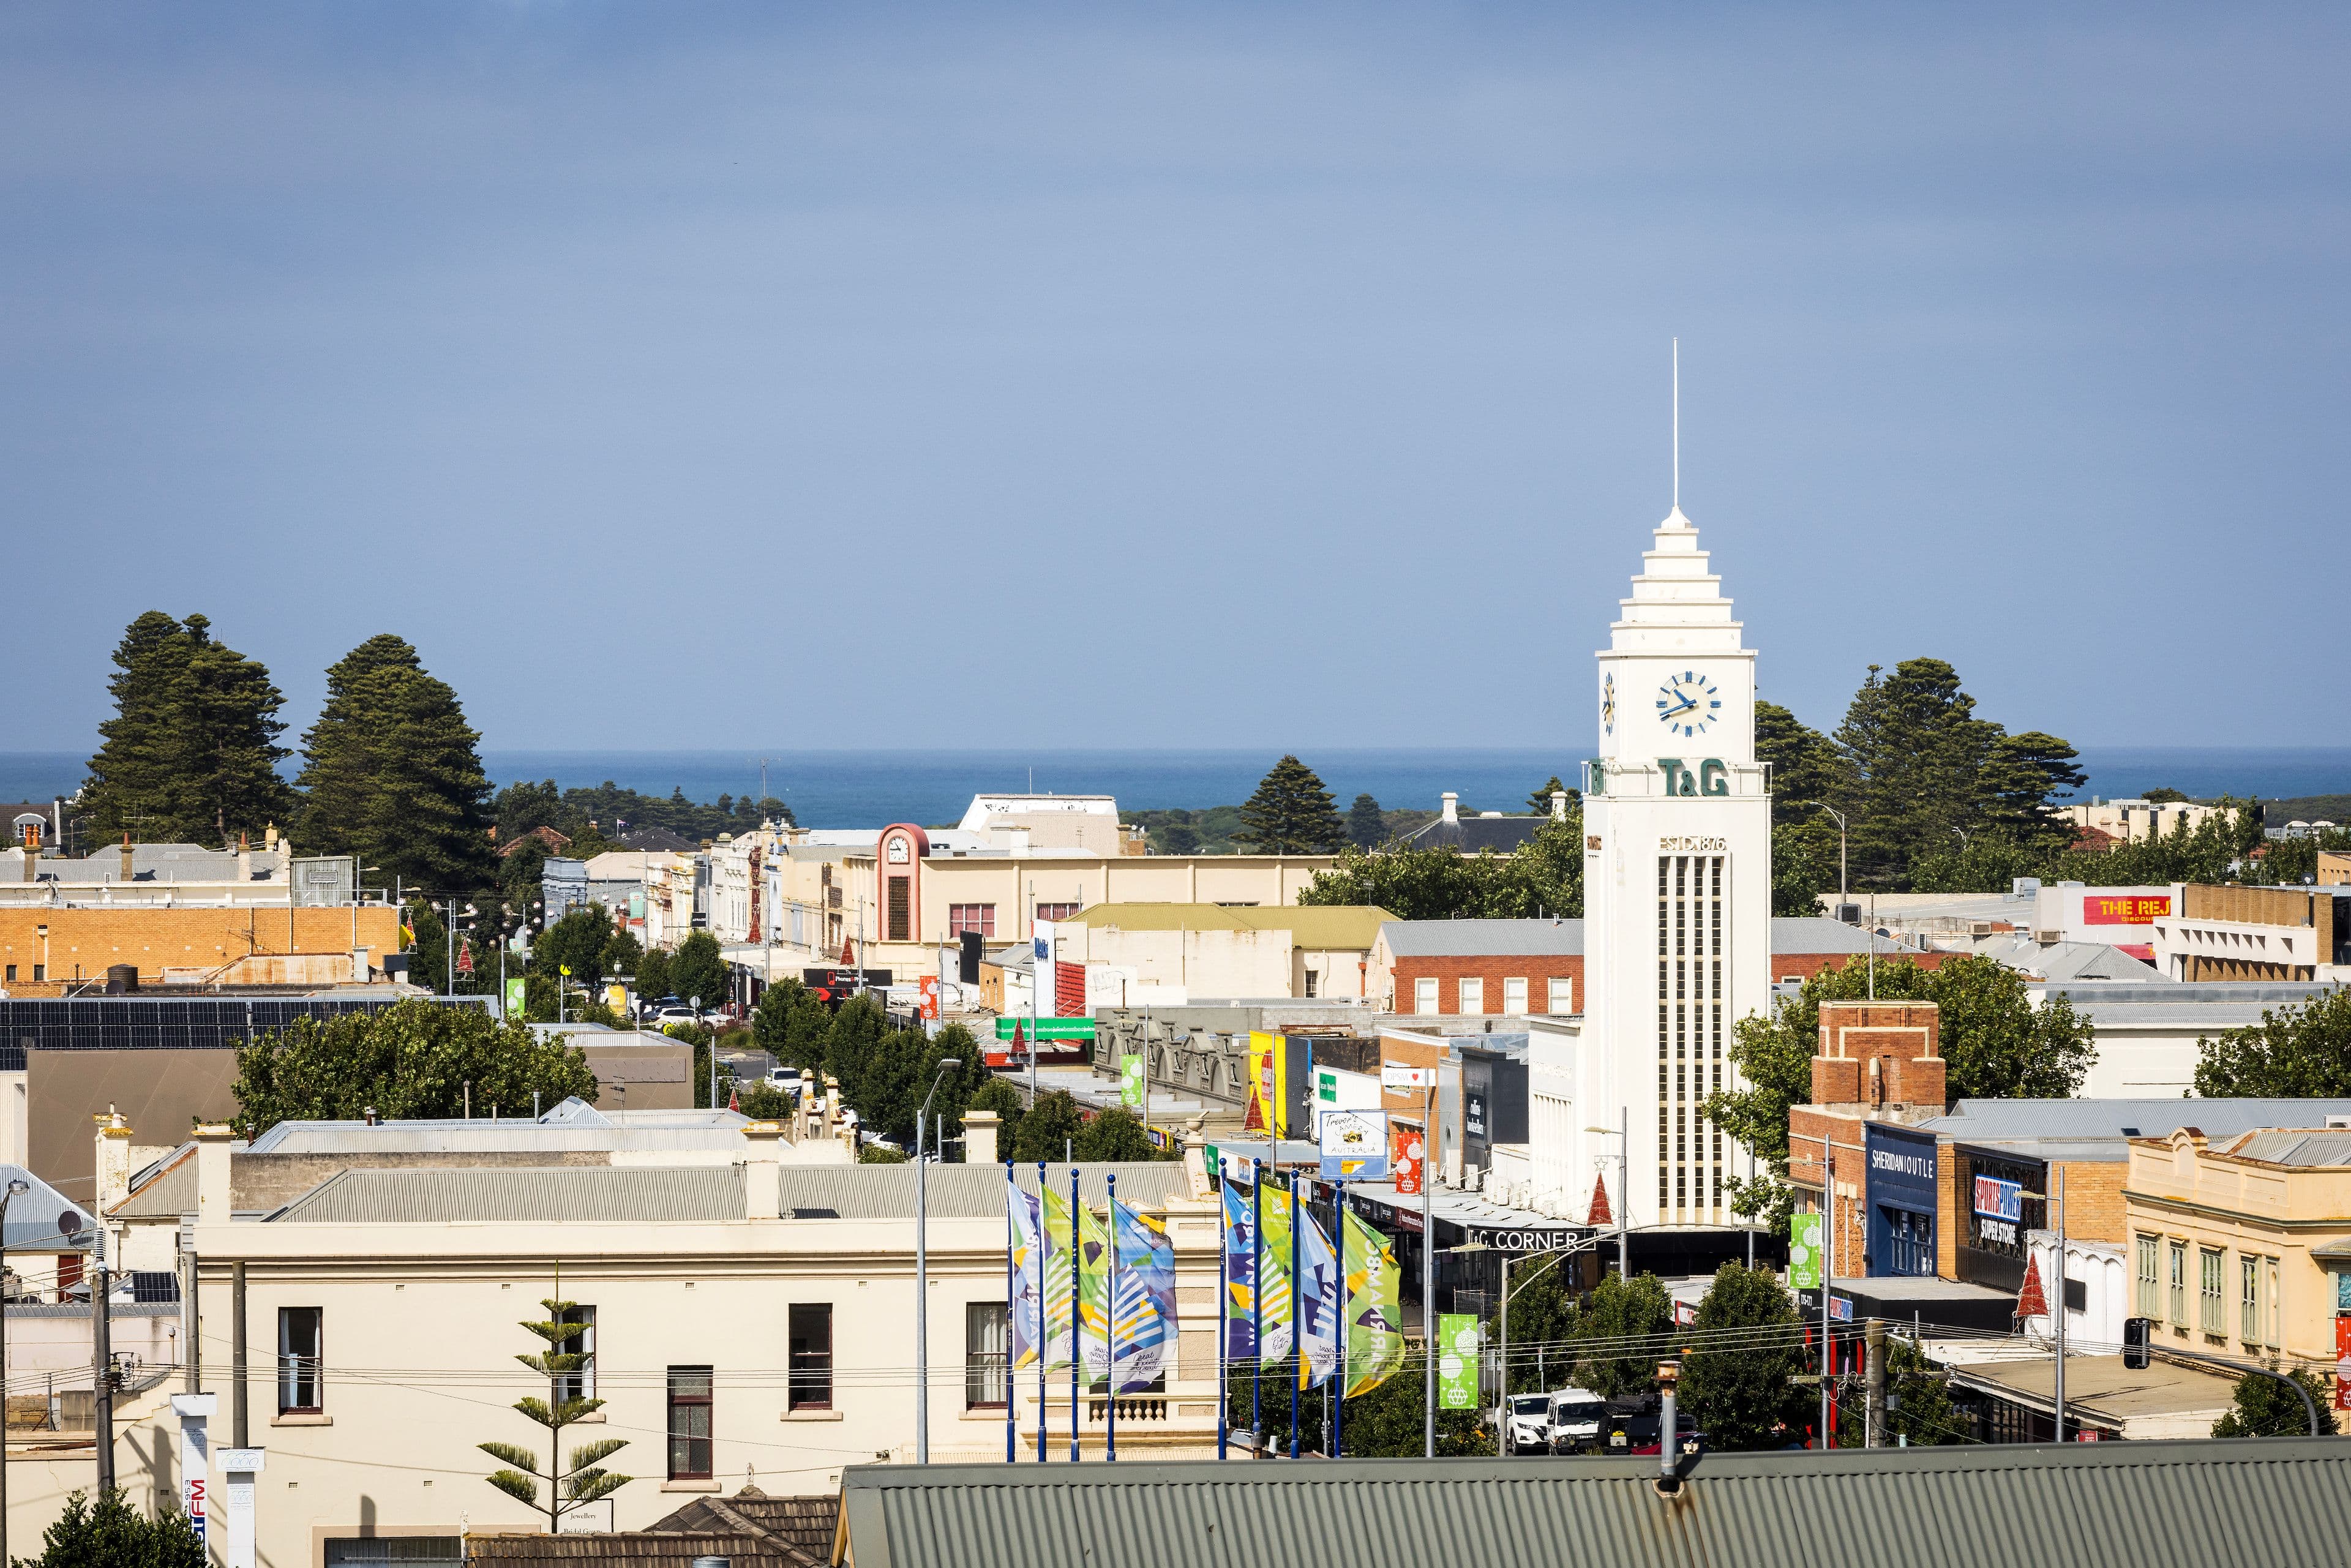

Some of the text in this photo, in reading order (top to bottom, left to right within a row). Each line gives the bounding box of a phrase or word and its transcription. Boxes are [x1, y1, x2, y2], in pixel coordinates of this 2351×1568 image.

[1658, 759, 1728, 796] T&G
[2100, 901, 2170, 915] THE REJ
[1385, 1073, 1408, 1081] OPSM
[1872, 1150, 1935, 1179] SHERIDAN OUTLE
[1496, 1231, 1578, 1250] CORNER
[1981, 1219, 2015, 1245] SUPER STORE
